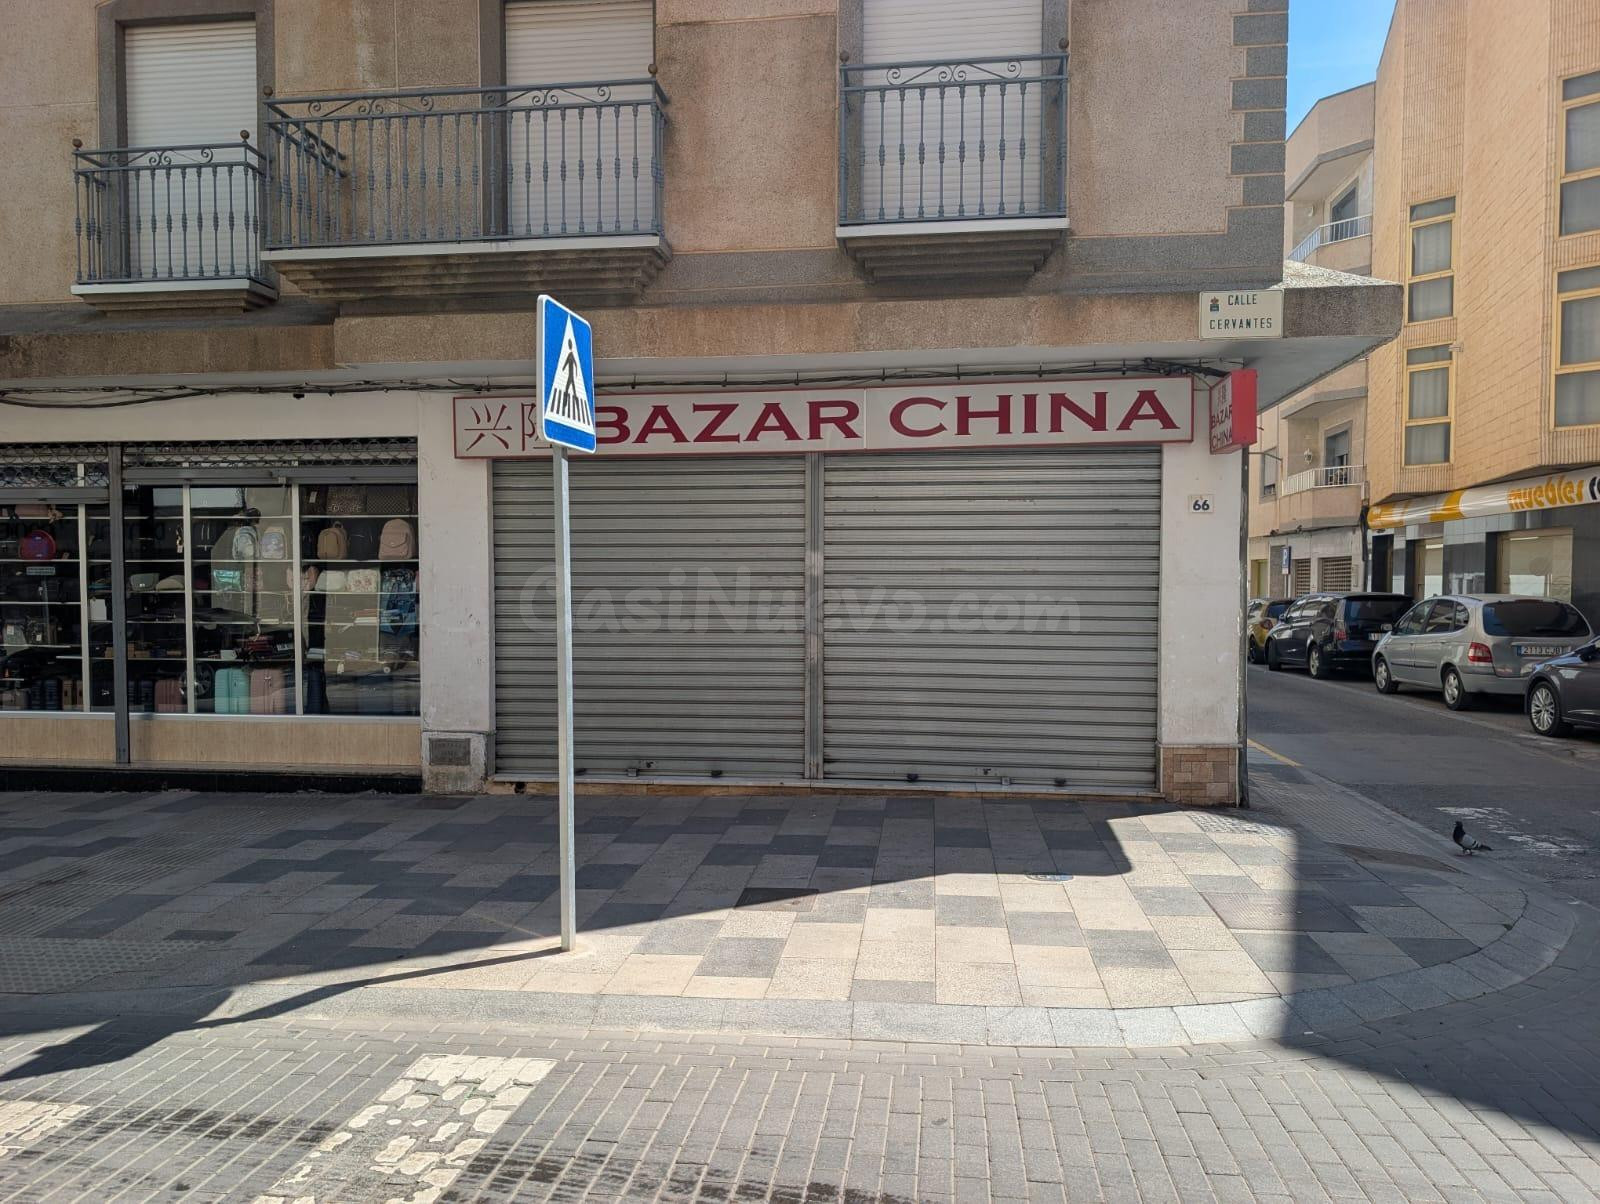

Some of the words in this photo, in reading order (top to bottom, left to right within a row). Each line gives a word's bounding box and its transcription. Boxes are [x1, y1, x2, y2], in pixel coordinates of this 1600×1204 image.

[1227, 294, 1257, 306] CALLE
[1209, 317, 1272, 330] CERVANTES
[594, 400, 862, 444] BAZAR
[889, 390, 1181, 437] CHINA
[1507, 474, 1585, 511] muebles
[1192, 499, 1210, 511] 66
